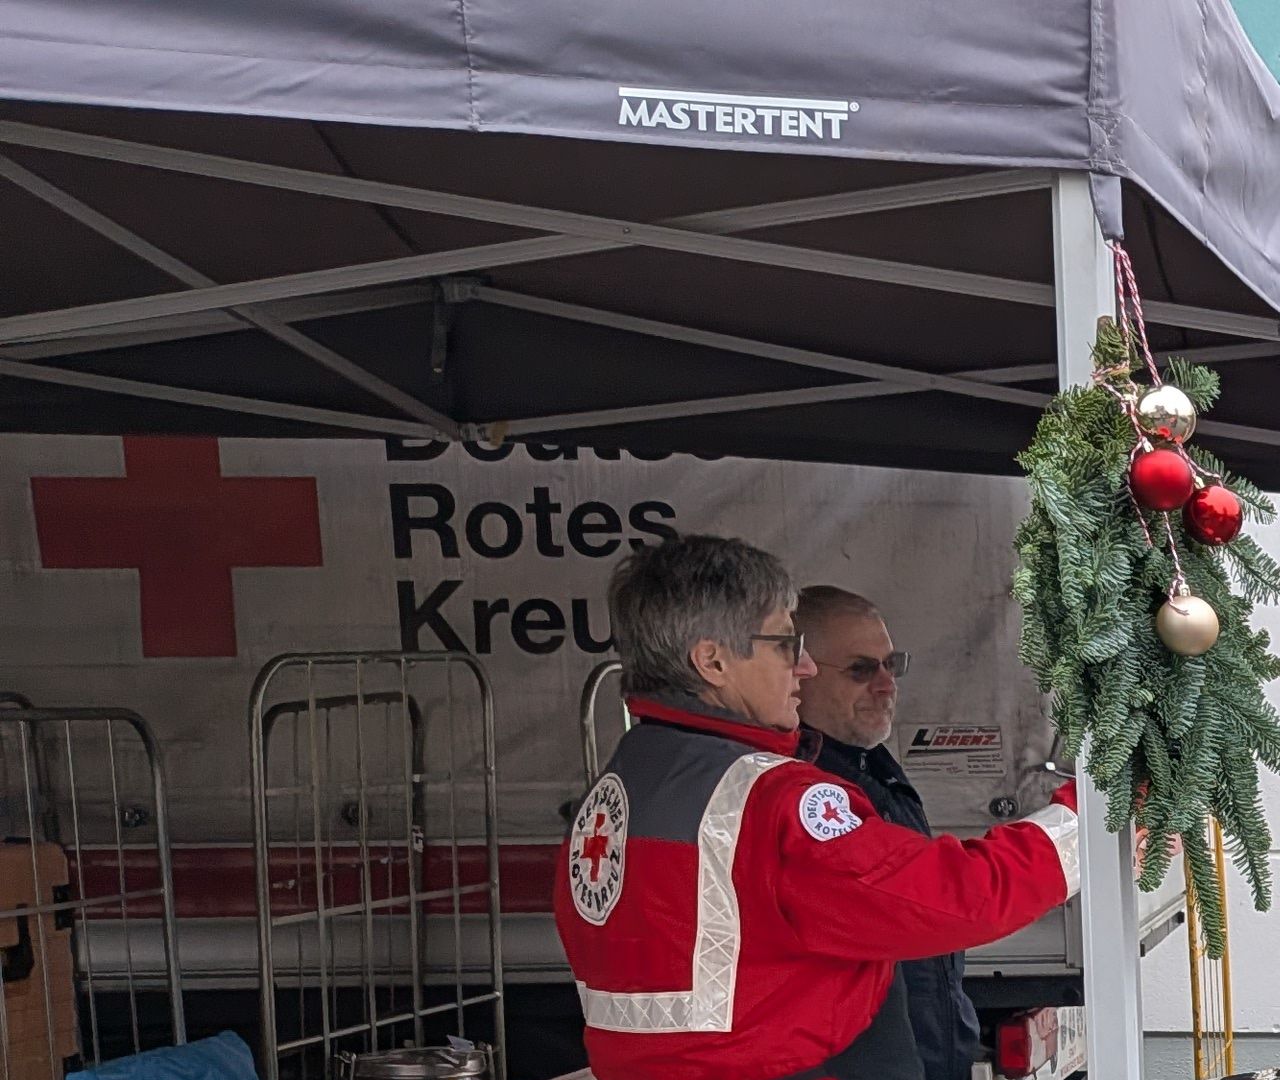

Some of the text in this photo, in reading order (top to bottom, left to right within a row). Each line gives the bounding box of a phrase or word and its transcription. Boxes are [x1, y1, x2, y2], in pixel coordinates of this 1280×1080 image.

[389, 483, 679, 558] Rotes
[911, 728, 997, 747] LORENZ
[807, 789, 845, 819] DEUTSCHES
